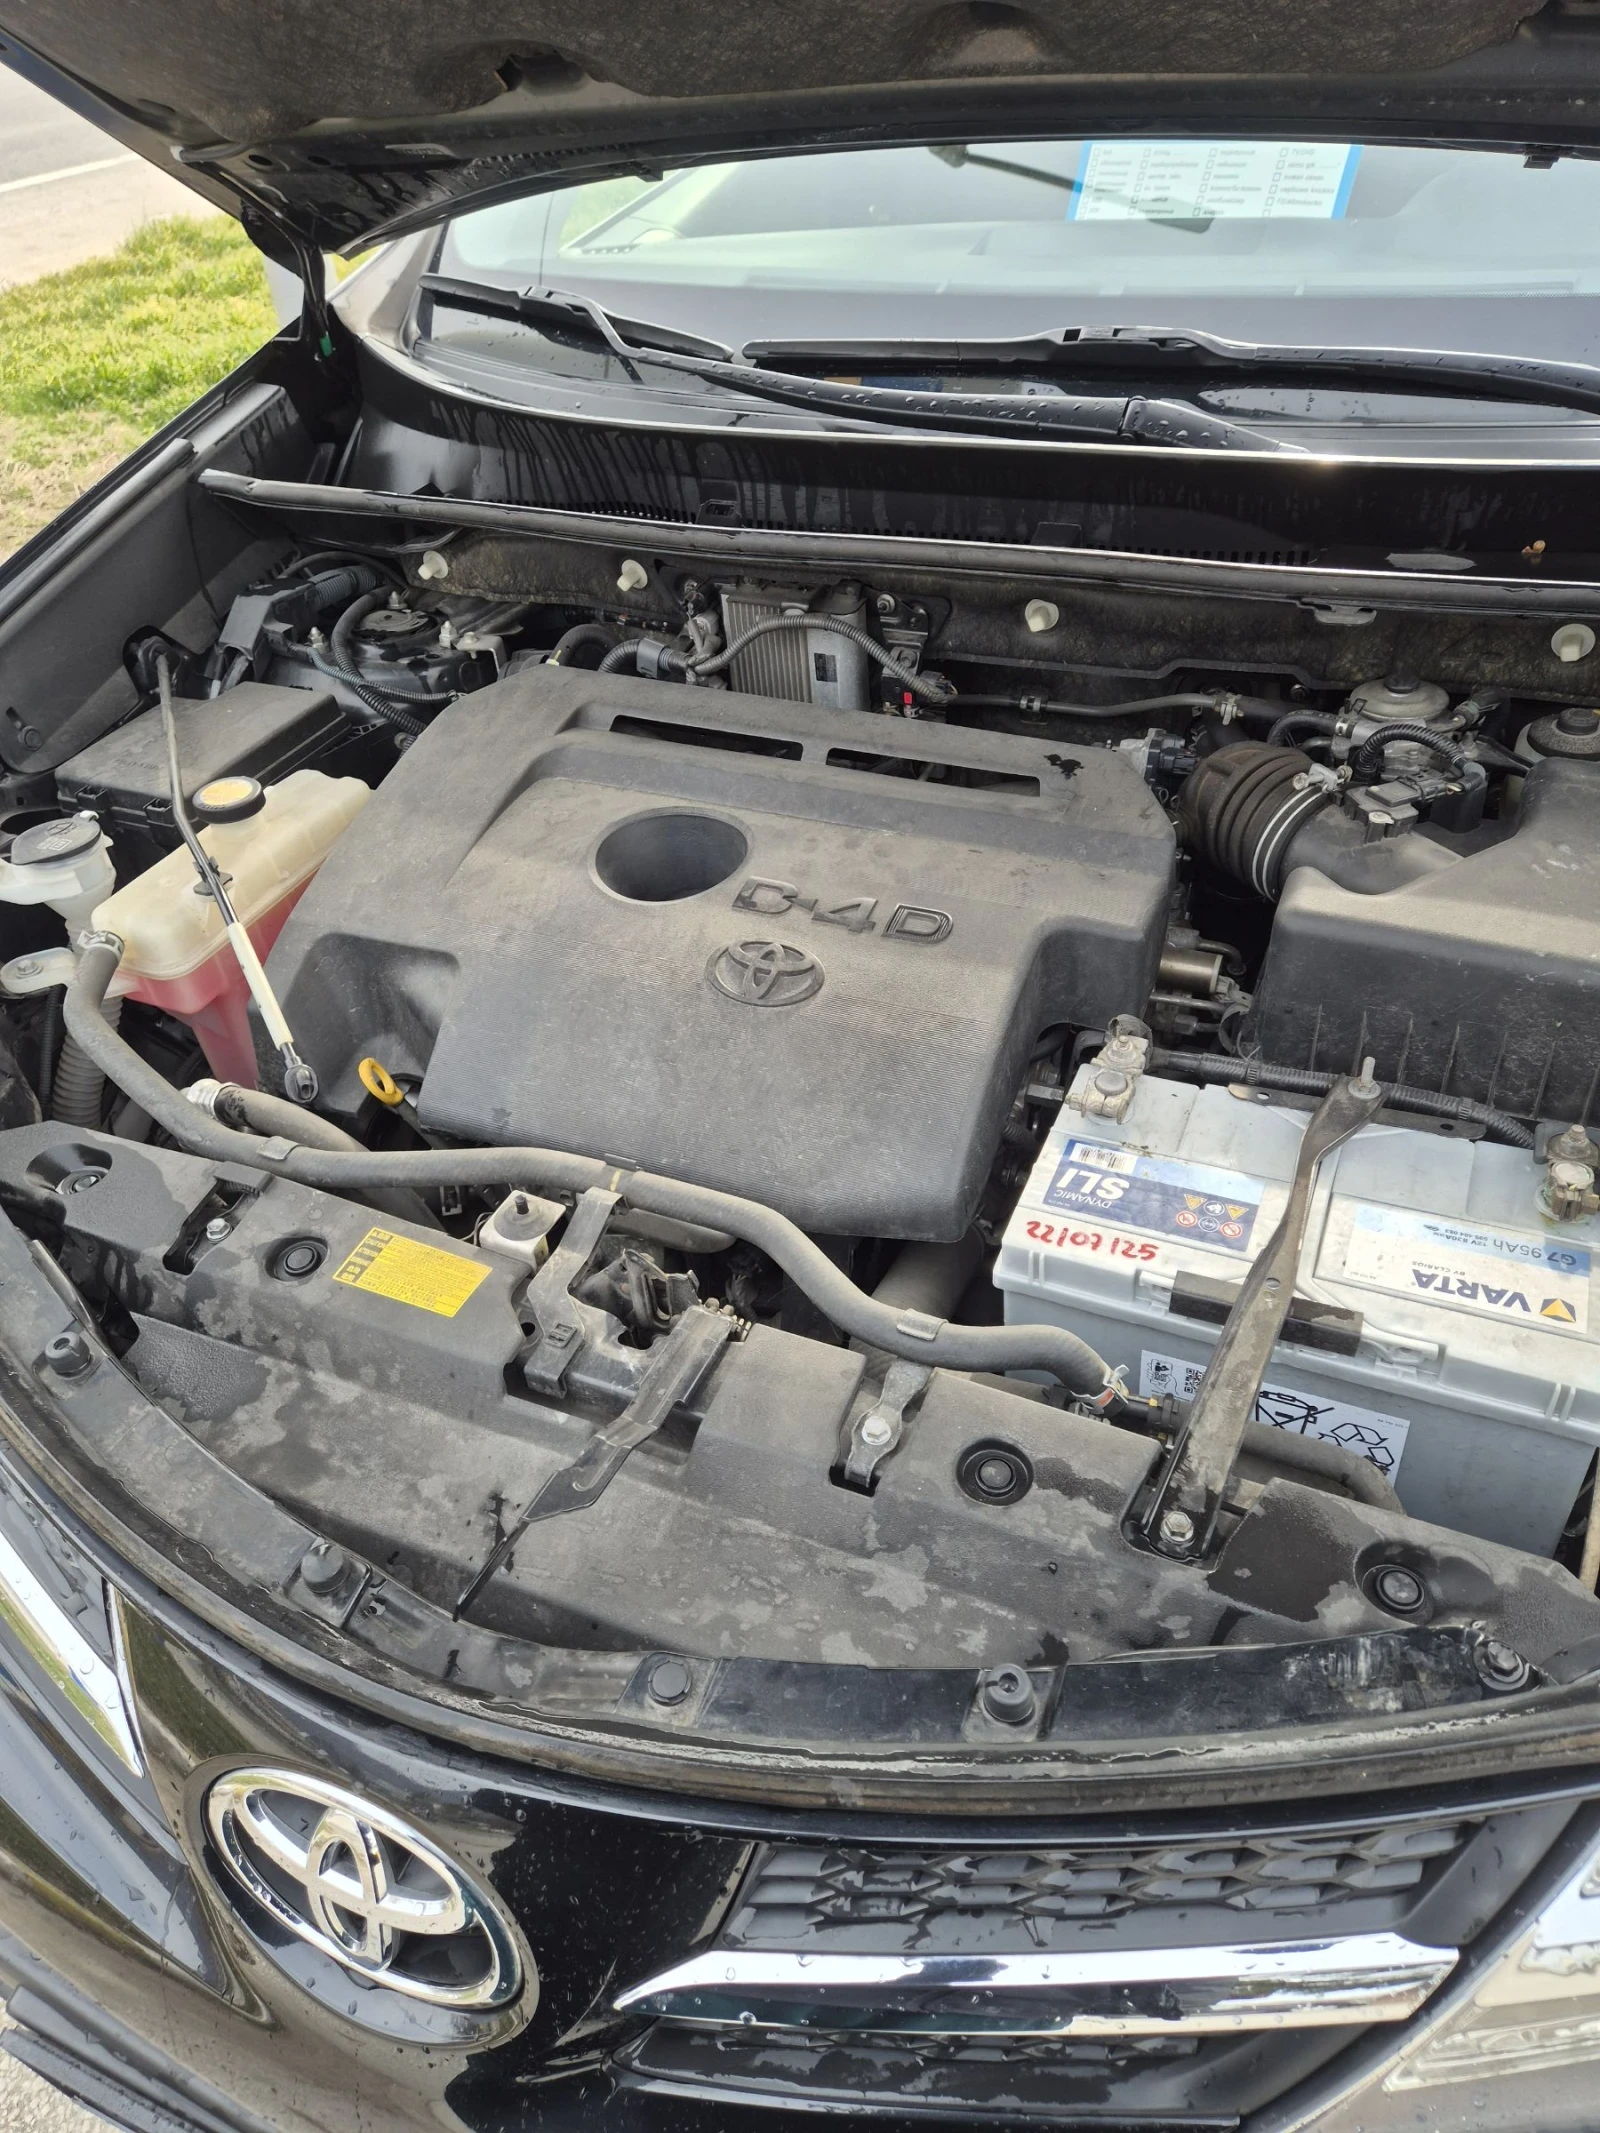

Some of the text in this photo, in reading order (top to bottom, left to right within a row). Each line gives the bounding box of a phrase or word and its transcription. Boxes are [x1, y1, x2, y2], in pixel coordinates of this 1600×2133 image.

[1056, 1169, 1129, 1200] SLI
[1054, 1189, 1112, 1209] DYNAMIC
[1493, 1239, 1577, 1266] G7 95Ah
[1412, 1261, 1451, 1272] CLARIOS
[1412, 1269, 1531, 1312] VARTA
